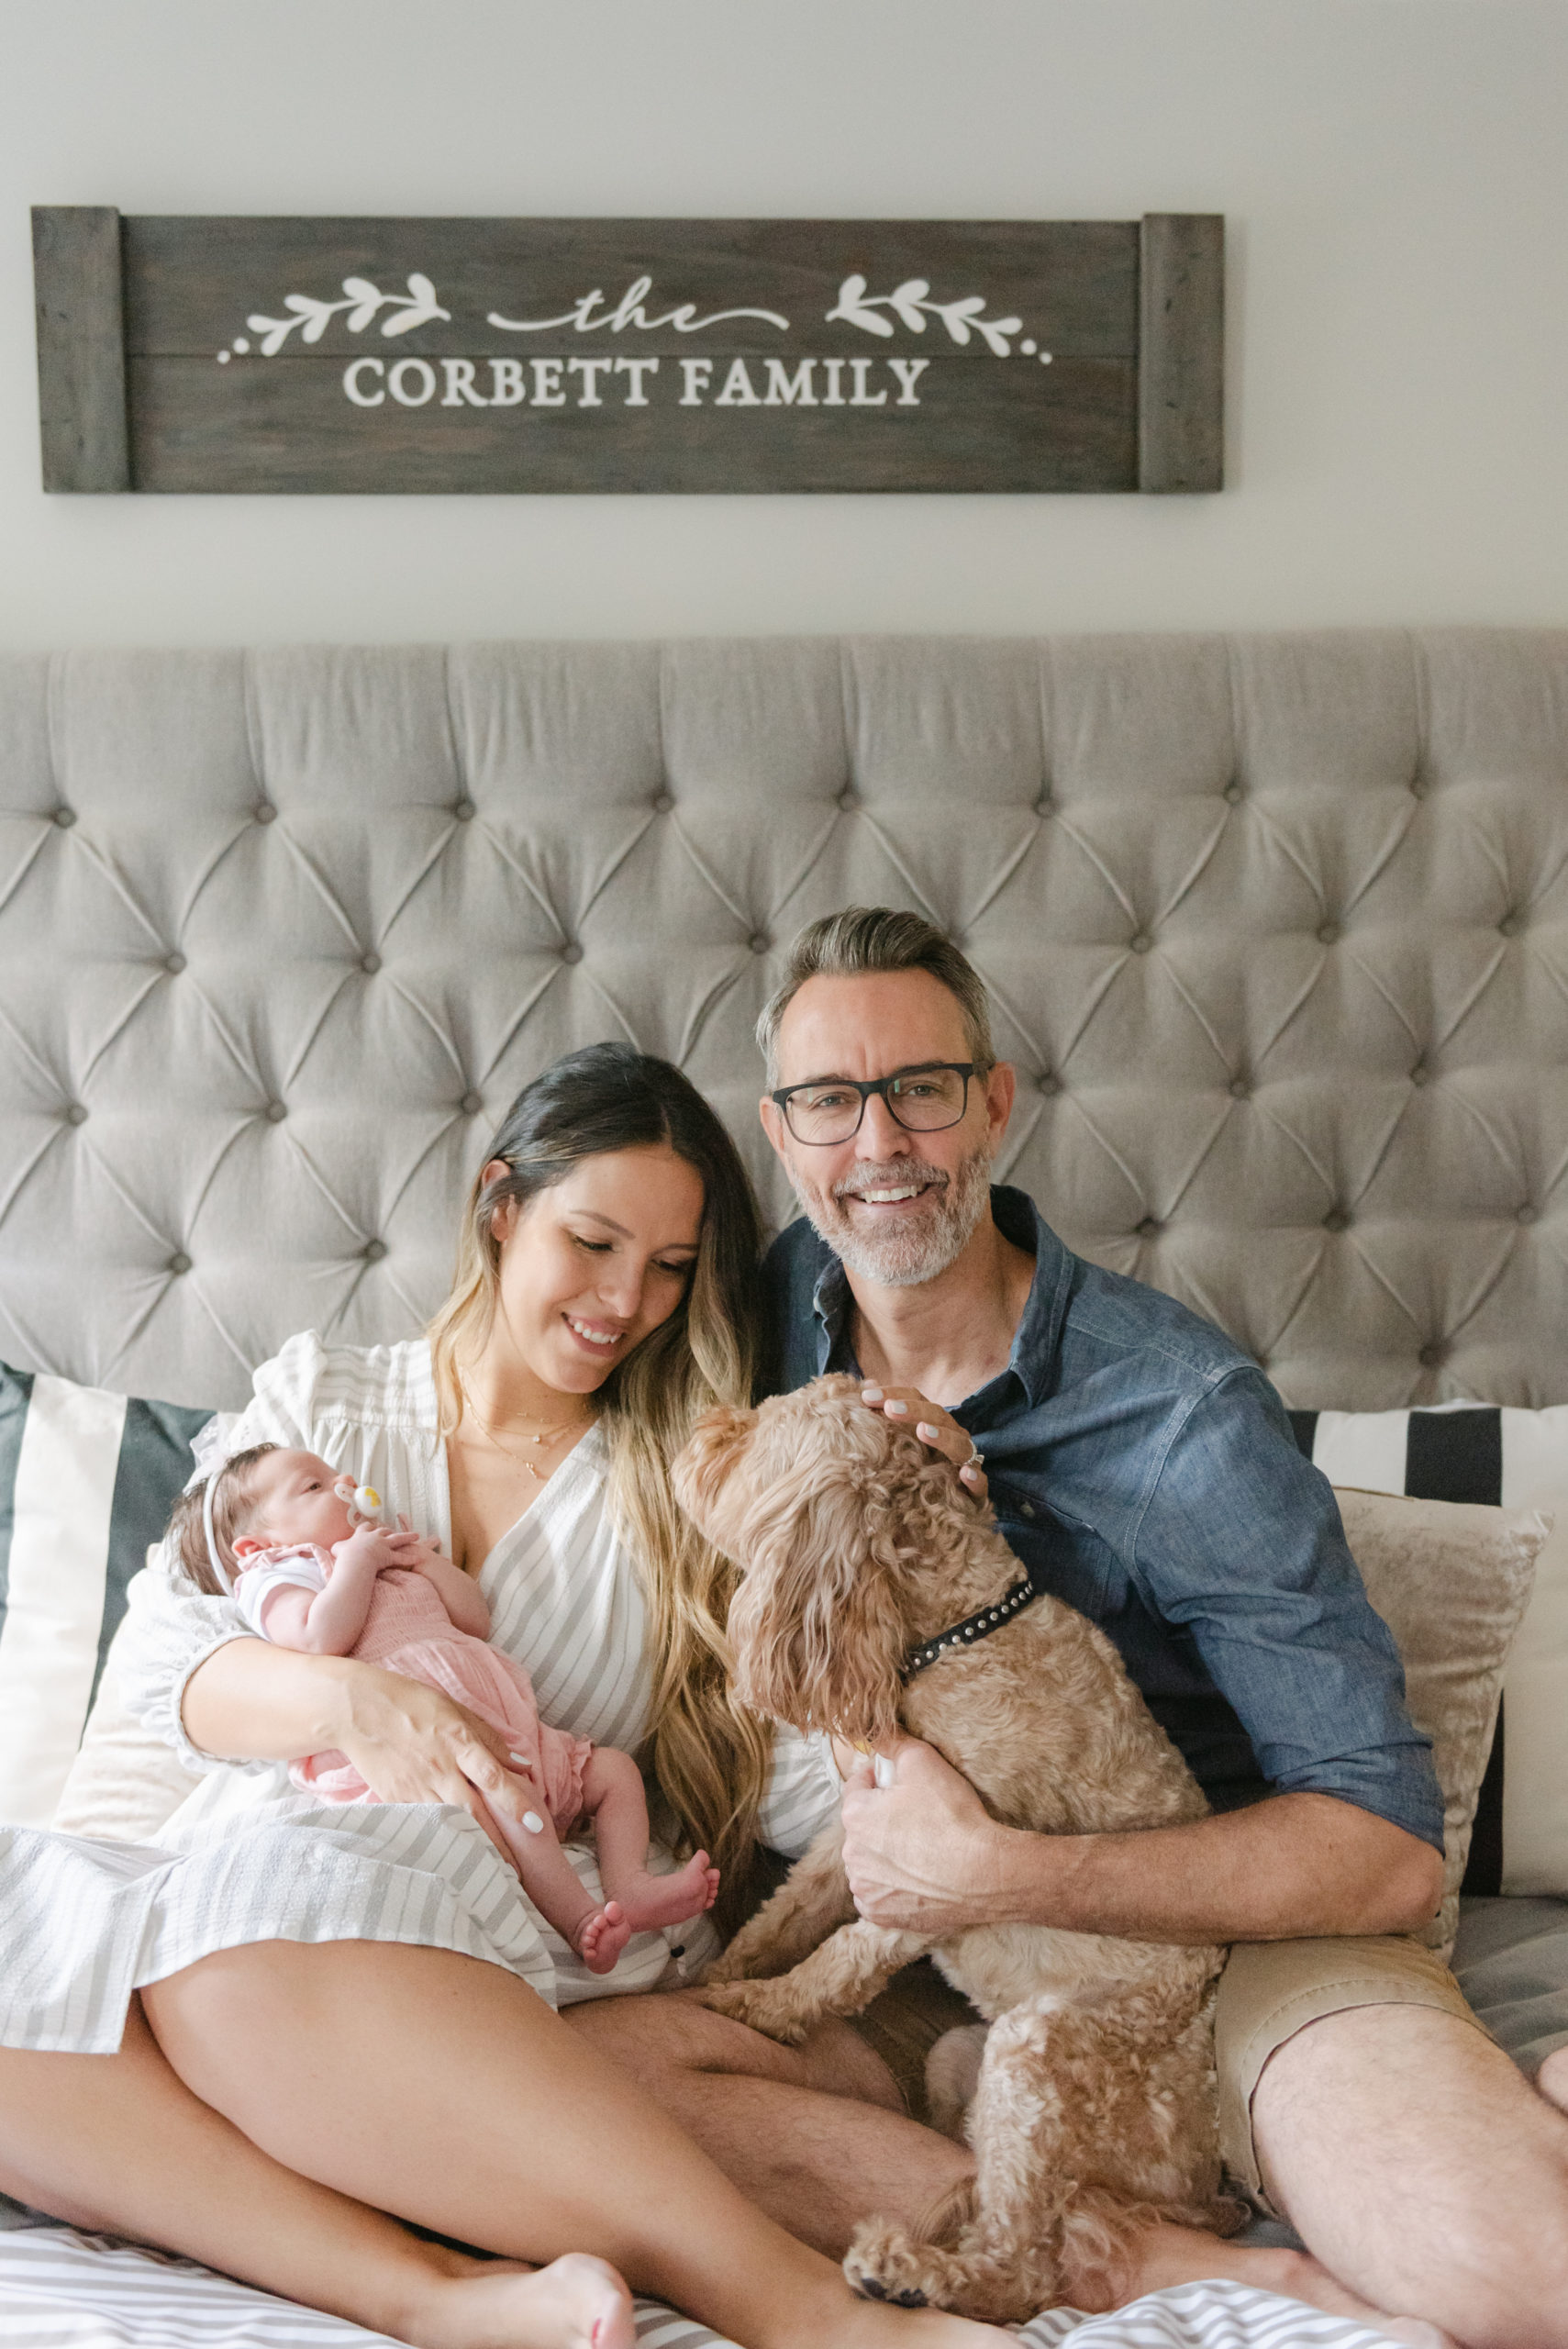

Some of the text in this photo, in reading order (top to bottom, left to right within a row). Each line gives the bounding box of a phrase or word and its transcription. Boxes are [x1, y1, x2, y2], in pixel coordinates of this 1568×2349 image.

[487, 274, 791, 333] the
[342, 357, 930, 408] CORBETT FAMILY
